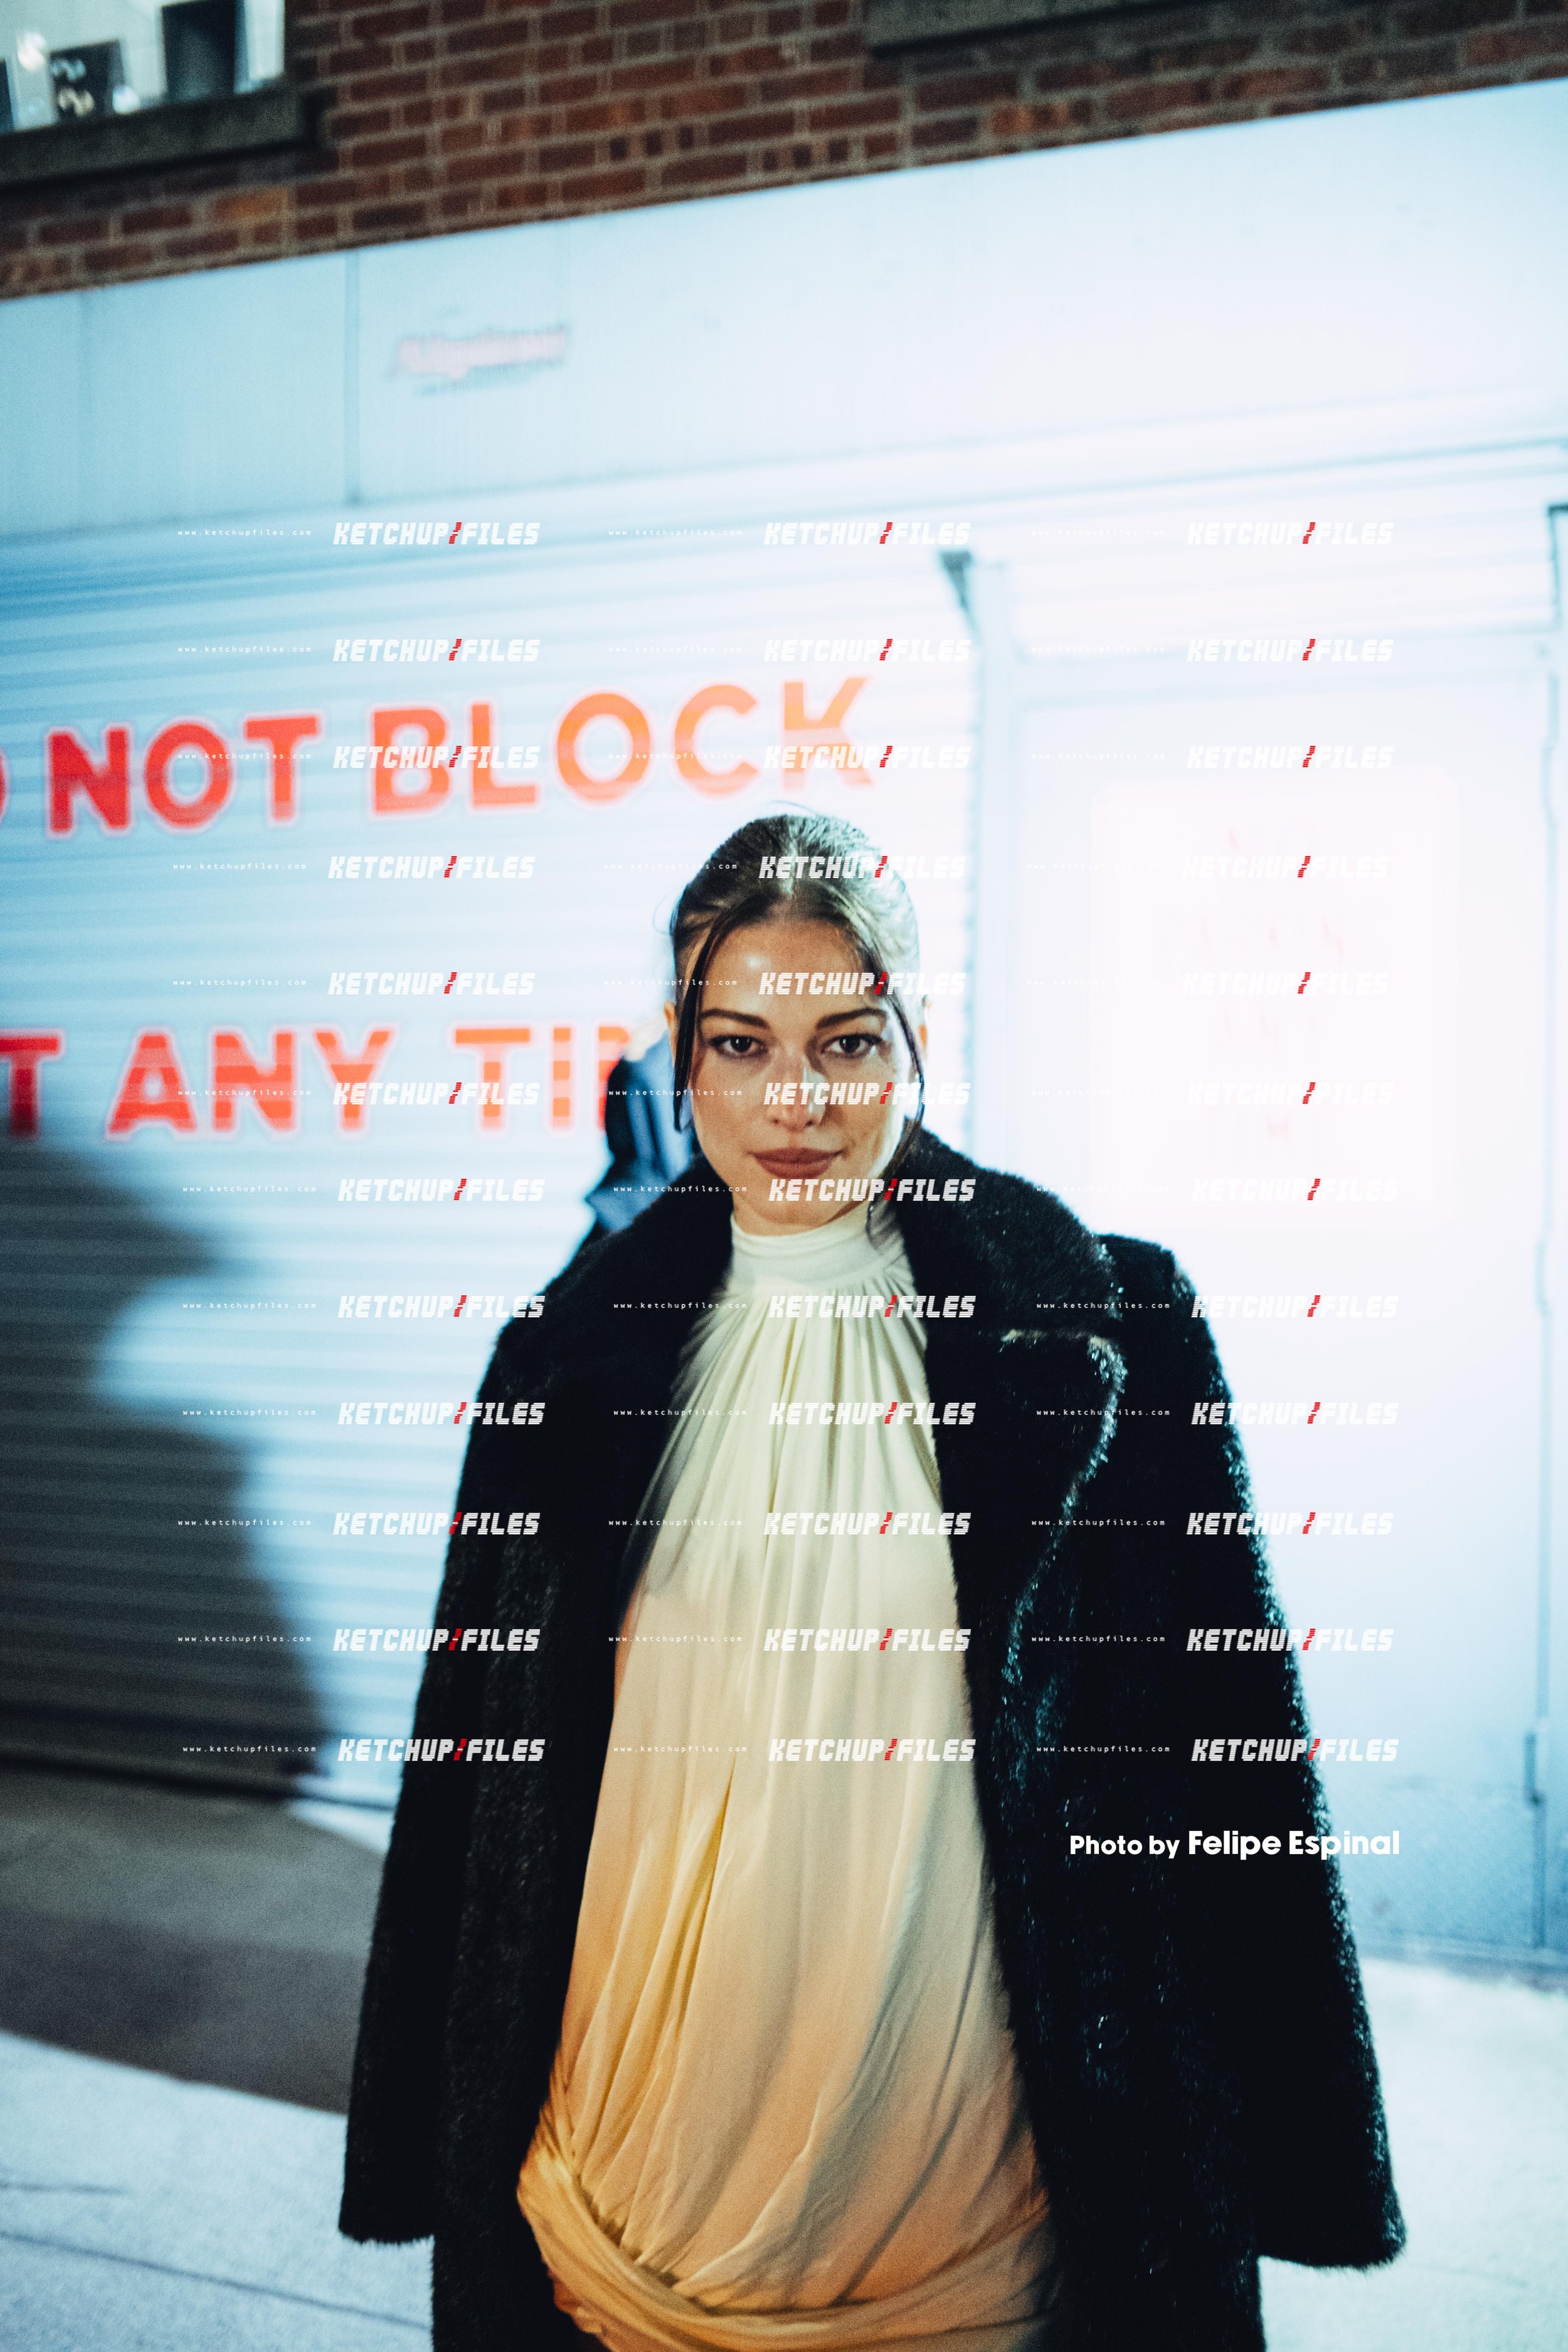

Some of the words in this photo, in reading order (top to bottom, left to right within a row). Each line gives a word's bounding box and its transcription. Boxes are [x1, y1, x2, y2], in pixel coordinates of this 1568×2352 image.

[50, 718, 317, 833] NOT
[373, 677, 874, 813] BLOCK
[108, 1031, 390, 1133] ANY
[455, 1026, 629, 1133] TI
